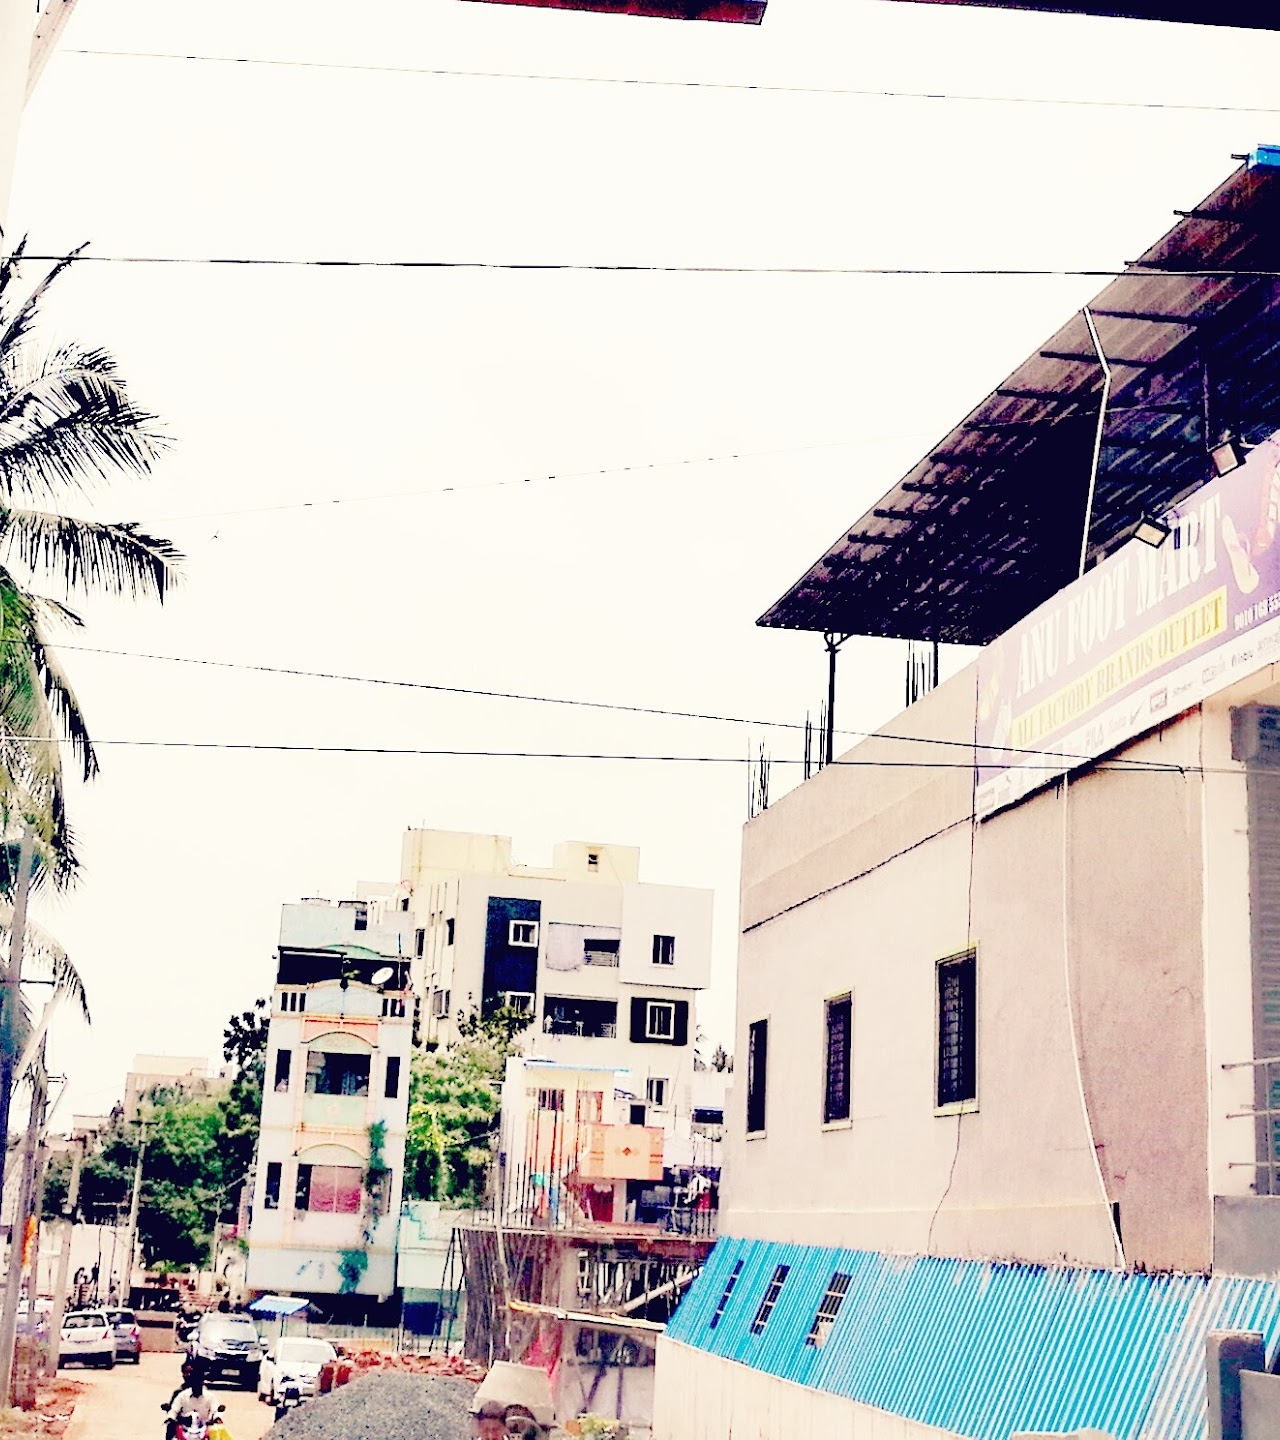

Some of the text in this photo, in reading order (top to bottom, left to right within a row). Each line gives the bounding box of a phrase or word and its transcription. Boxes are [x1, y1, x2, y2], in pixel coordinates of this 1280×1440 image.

[1067, 560, 1129, 665] FOOT
[1136, 495, 1220, 616] MART
[1096, 642, 1153, 700] BRANDS
[1158, 595, 1222, 658] OUTLET
